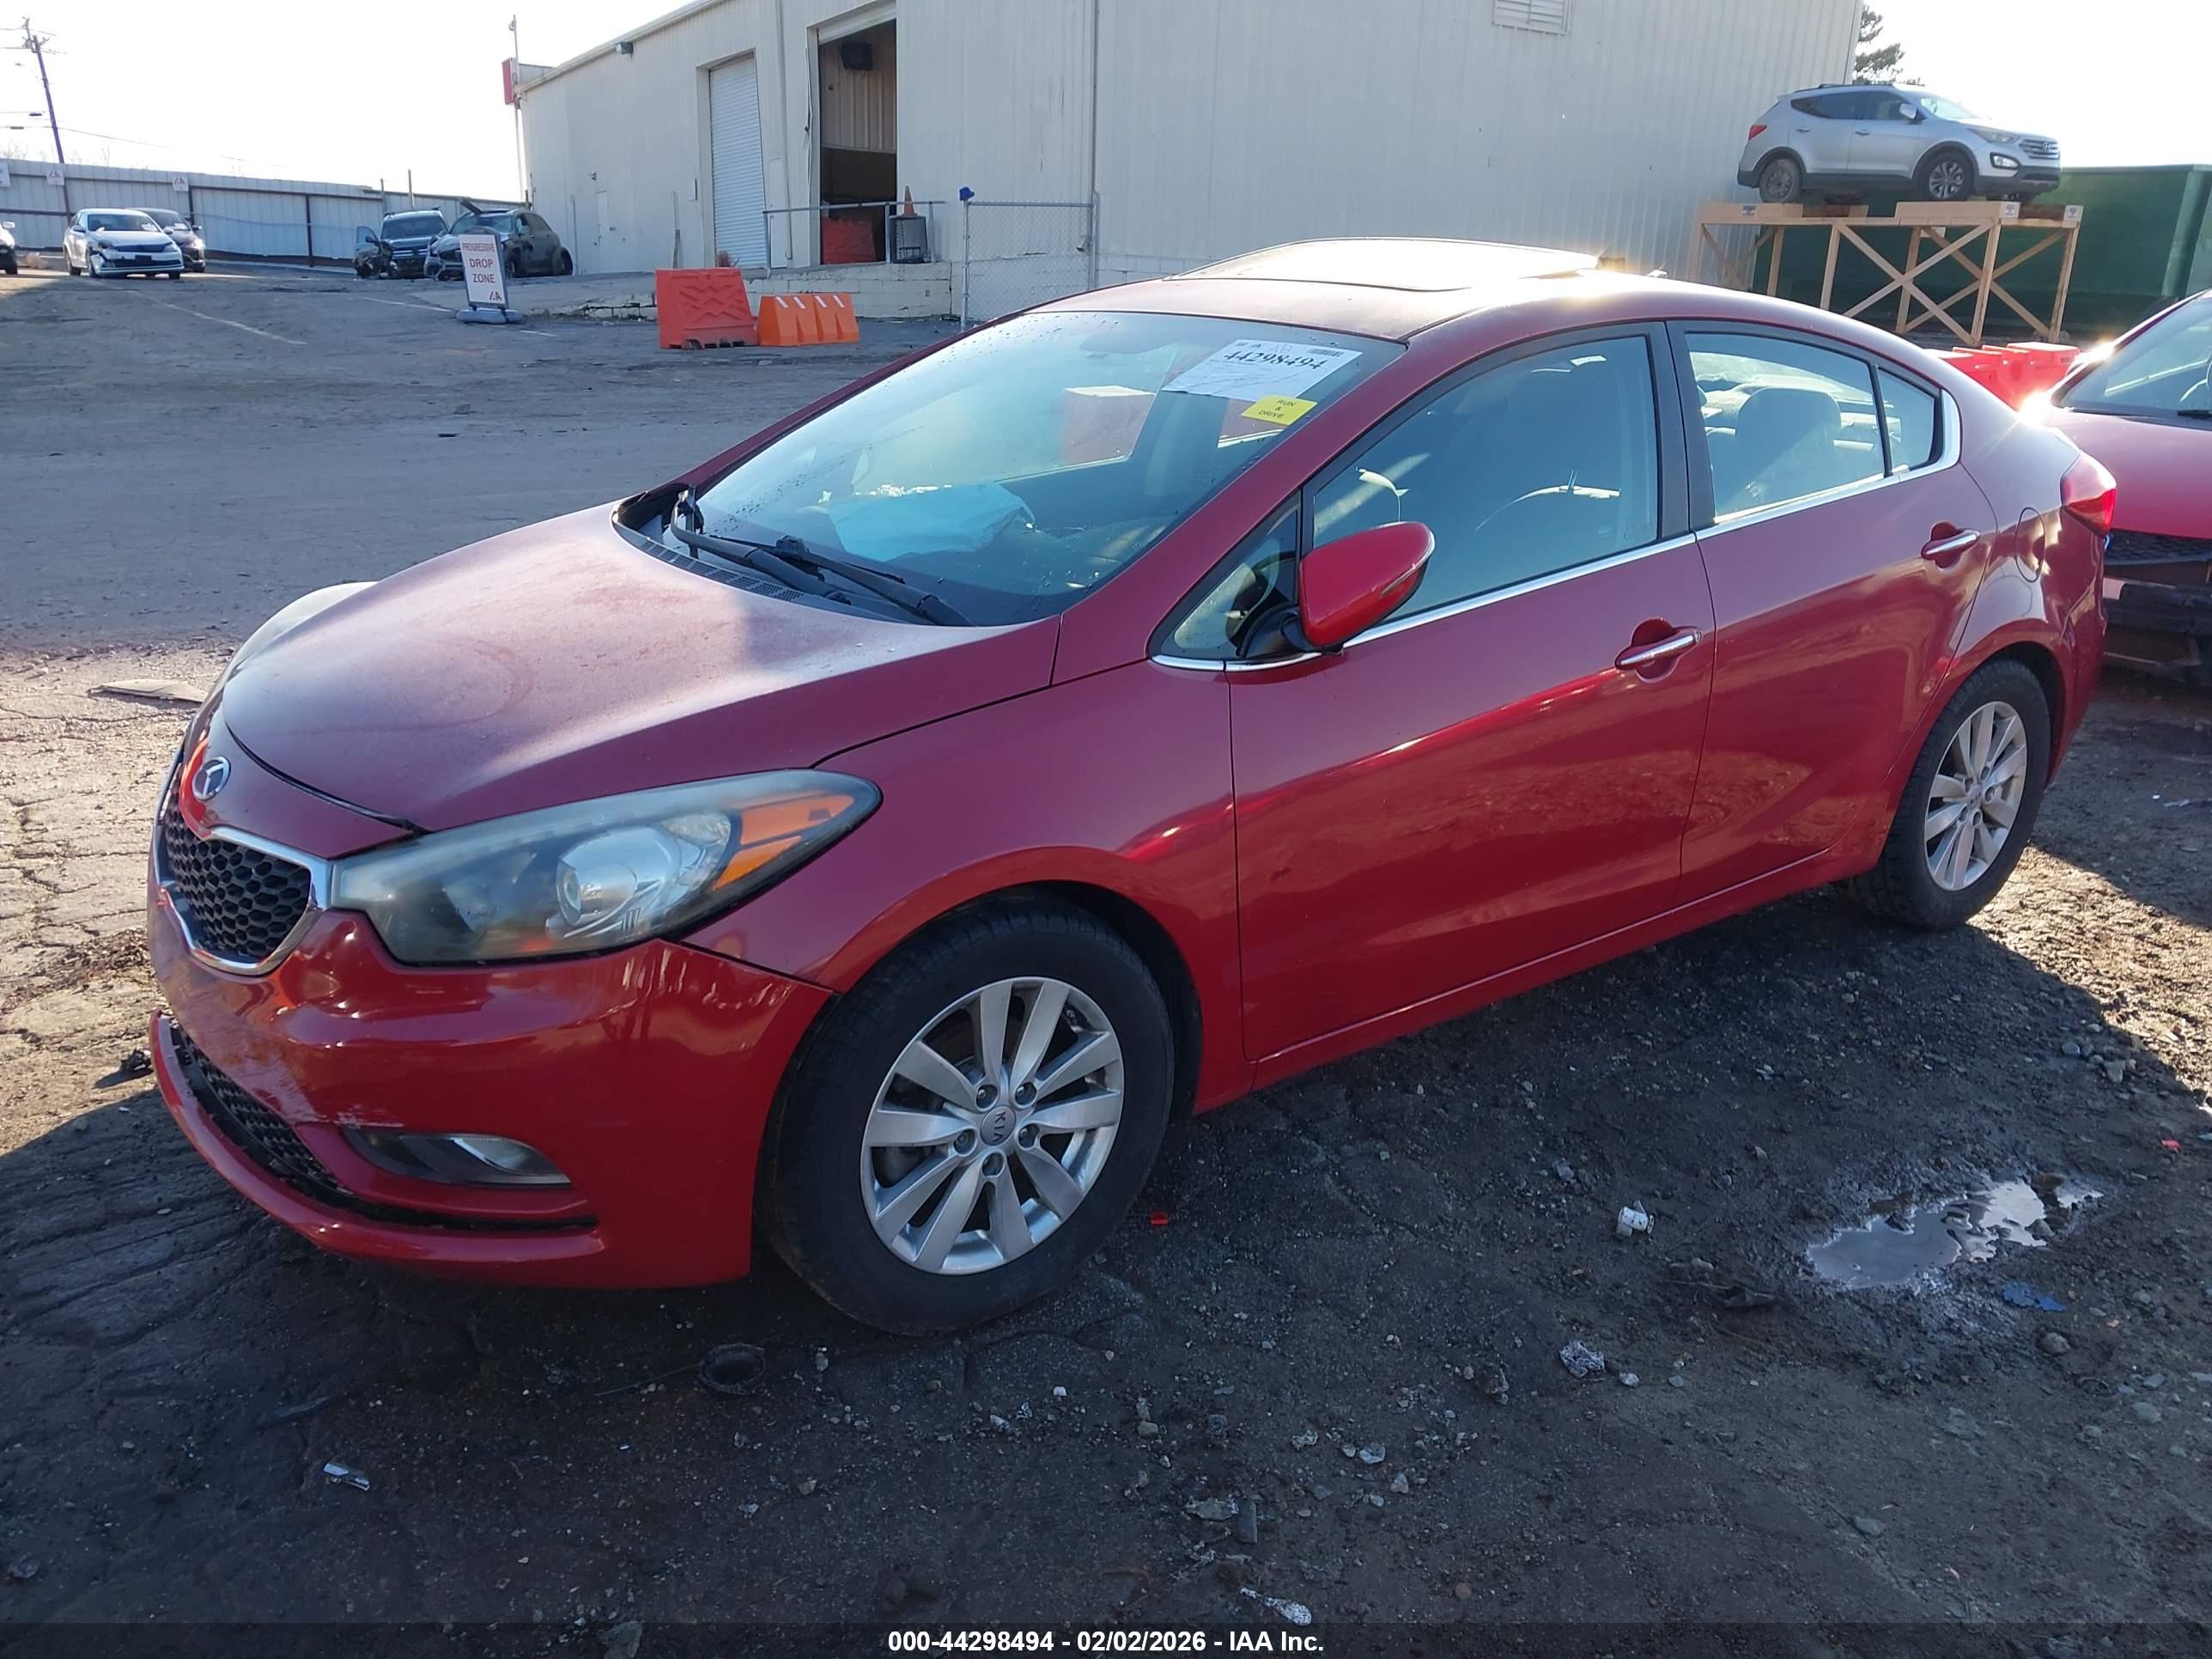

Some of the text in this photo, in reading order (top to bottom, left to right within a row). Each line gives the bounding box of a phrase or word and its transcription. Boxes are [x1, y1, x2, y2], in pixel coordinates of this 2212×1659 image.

[469, 258, 494, 268] DROP
[472, 274, 495, 283] ZONE
[1224, 350, 1328, 369] 44298494
[1276, 398, 1296, 407] RUN
[1258, 410, 1285, 418] DRIVE
[993, 1111, 1006, 1142] KIA
